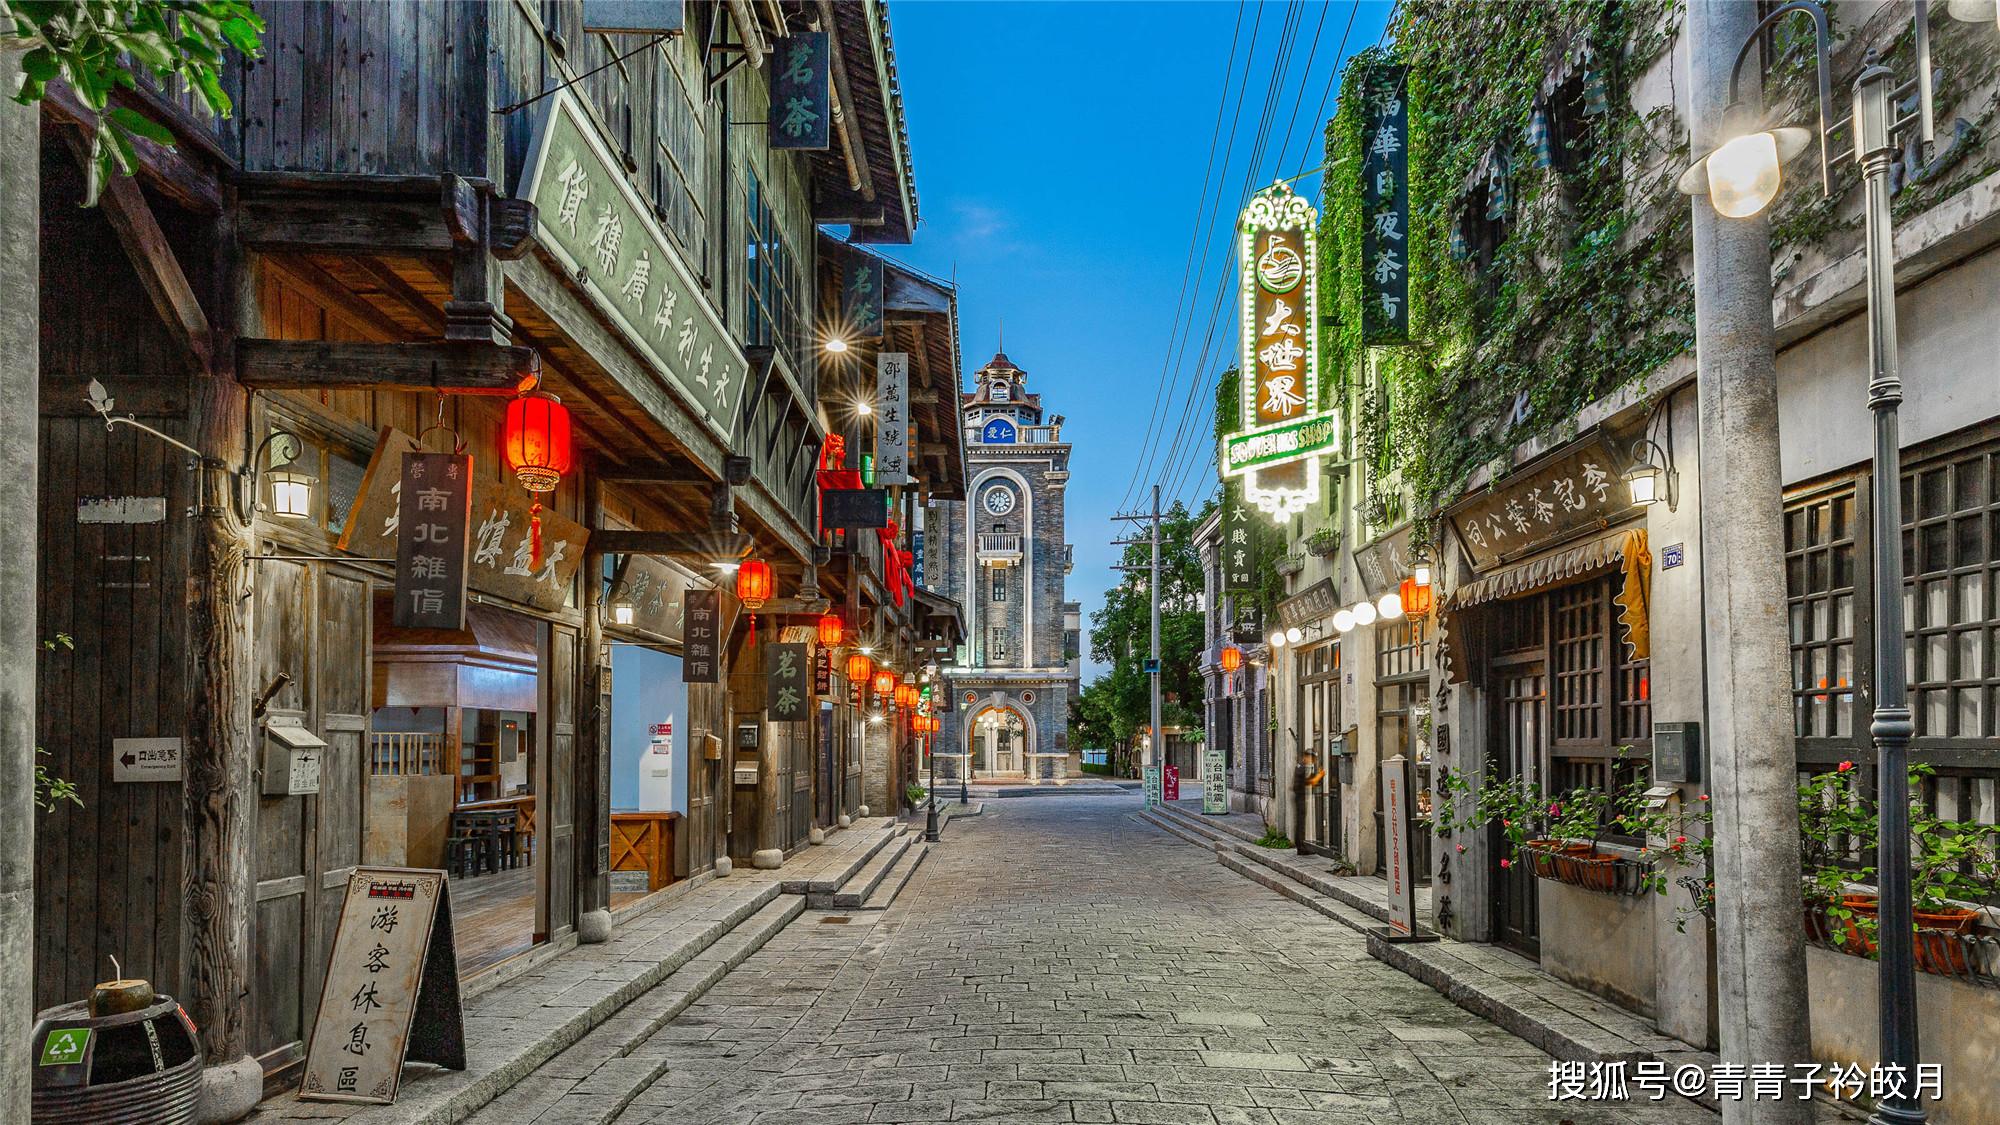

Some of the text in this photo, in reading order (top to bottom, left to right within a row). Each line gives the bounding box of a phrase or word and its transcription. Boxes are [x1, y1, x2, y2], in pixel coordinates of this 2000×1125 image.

[780, 44, 820, 137] 茗茶
[849, 266, 876, 328] 茗茶
[1260, 298, 1306, 417] 大世界
[1298, 420, 1333, 448] SHOP
[1465, 463, 1610, 549] 李記茶葉公司
[1667, 554, 1677, 565] 70
[772, 651, 801, 716] 茗茶
[336, 905, 400, 1093] 游客休息區
